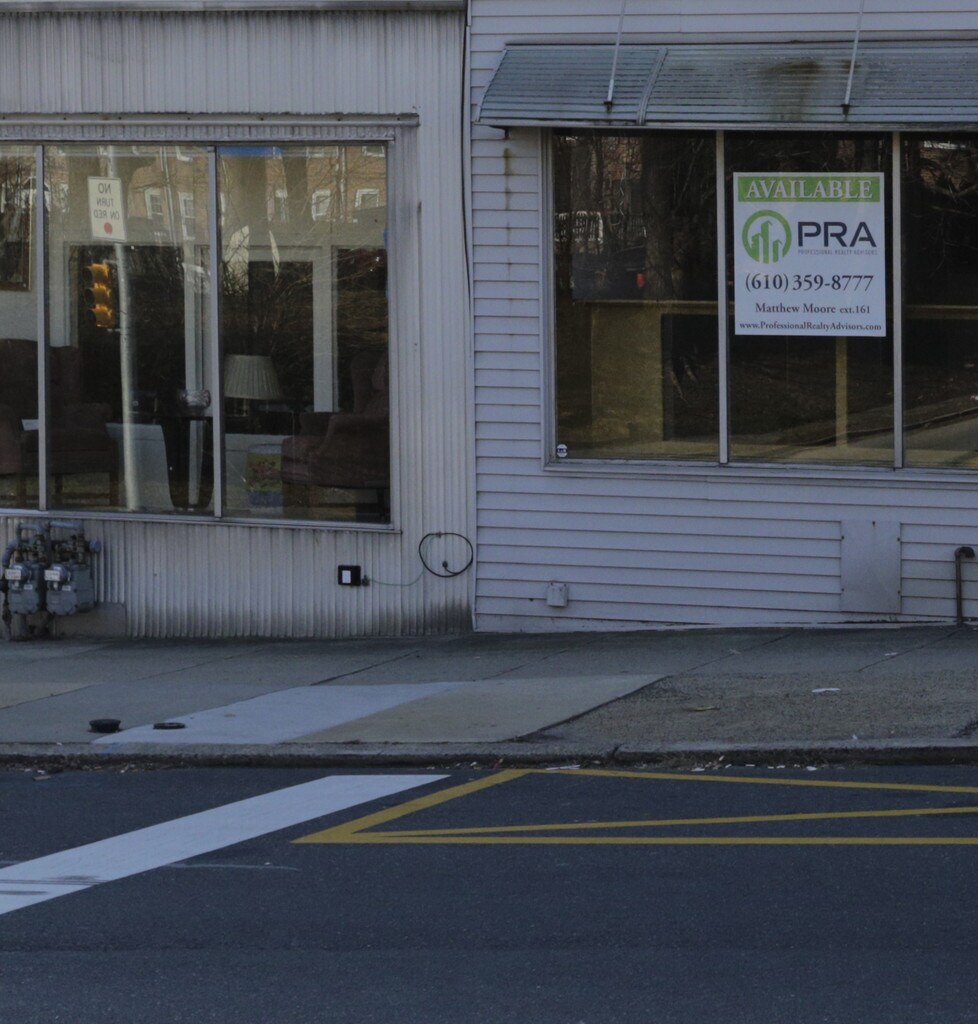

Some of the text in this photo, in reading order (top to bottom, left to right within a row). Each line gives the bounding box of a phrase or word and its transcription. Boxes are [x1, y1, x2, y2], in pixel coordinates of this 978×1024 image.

[745, 179, 873, 199] AVAILABLE
[797, 221, 877, 248] PRA
[745, 273, 874, 293] (610) 359-8777
[755, 302, 871, 314] Matthew Moore ext.161
[739, 321, 882, 332] www.ProfessionalRealtyAdvisors.com
